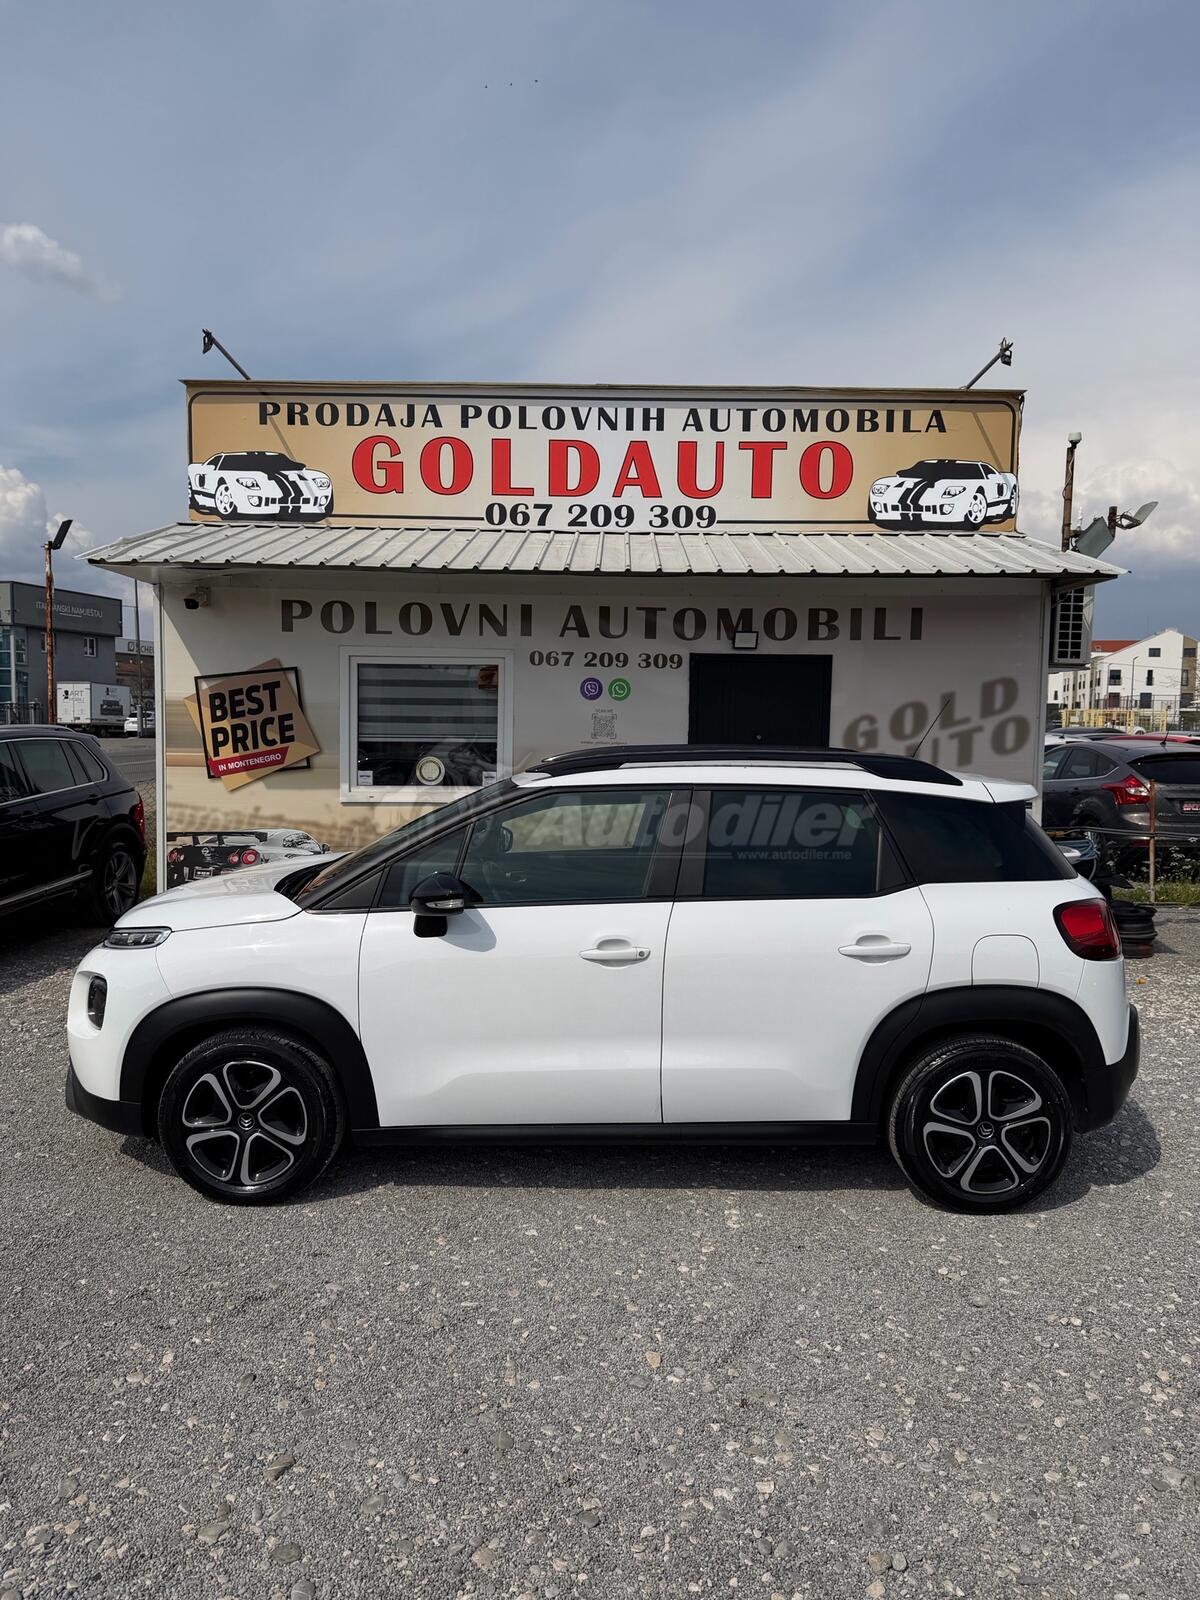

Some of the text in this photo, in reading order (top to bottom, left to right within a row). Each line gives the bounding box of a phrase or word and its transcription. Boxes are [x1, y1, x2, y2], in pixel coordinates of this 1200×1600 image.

[258, 401, 947, 434] PRODAJA POLOVNIH AUTOMOBILA
[351, 434, 854, 500] GOLDAUTO
[485, 502, 717, 529] 067 209 309
[281, 599, 924, 642] POLOVNI AUTOMOBILI
[529, 650, 683, 670] 067 209 309
[208, 681, 280, 723] BEST
[843, 676, 1019, 750] GOLD
[211, 713, 294, 757] PRICE
[218, 753, 281, 772] IN MONTENEGRO
